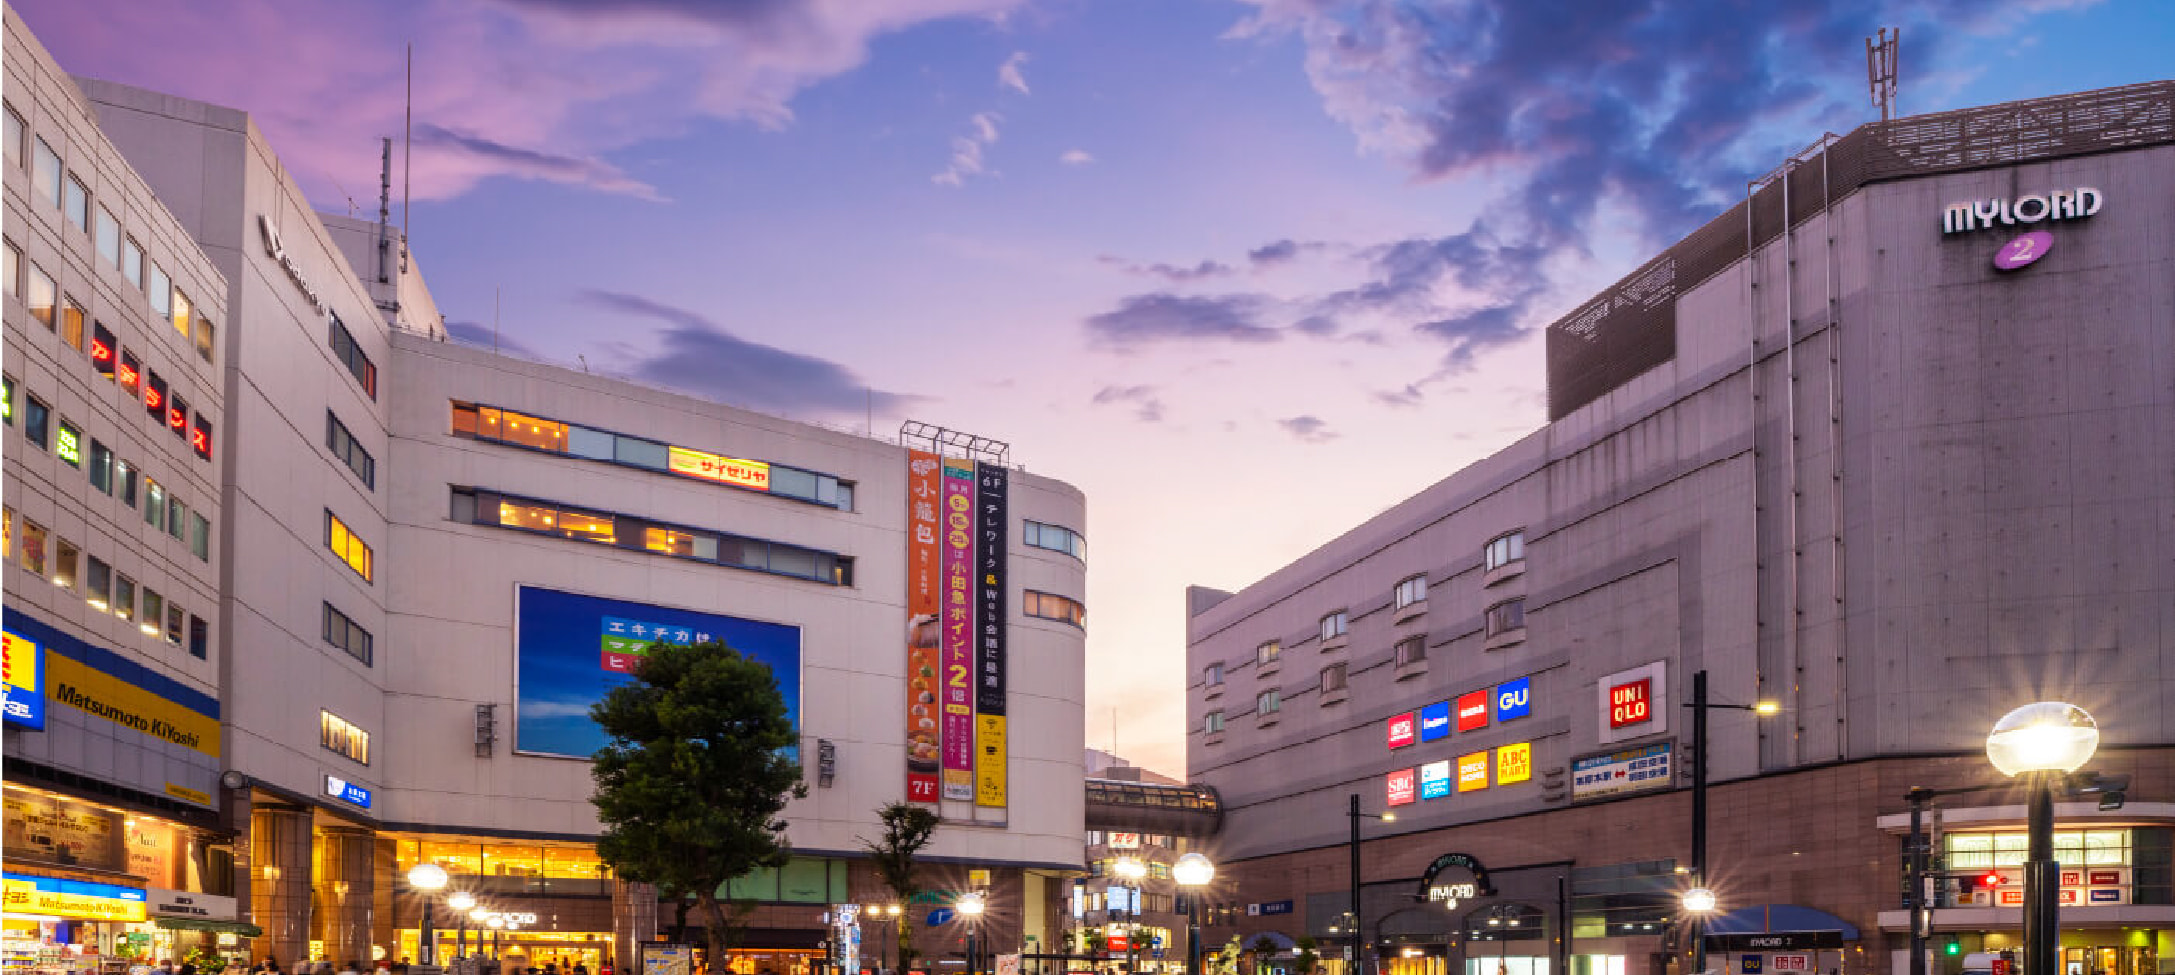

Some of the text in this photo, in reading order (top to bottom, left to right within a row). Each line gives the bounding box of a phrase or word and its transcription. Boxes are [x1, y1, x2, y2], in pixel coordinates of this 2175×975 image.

[1943, 187, 2103, 233] MYLORD
[2009, 238, 2035, 262] 2
[701, 461, 766, 482] サイゼリヤ
[1499, 688, 1528, 711] GU
[1614, 684, 1642, 704] UNI
[57, 683, 200, 748] Matsumoto KiYoshi
[1614, 702, 1645, 723] QLO
[1501, 749, 1527, 768] ABC
[912, 780, 935, 795] 7F
